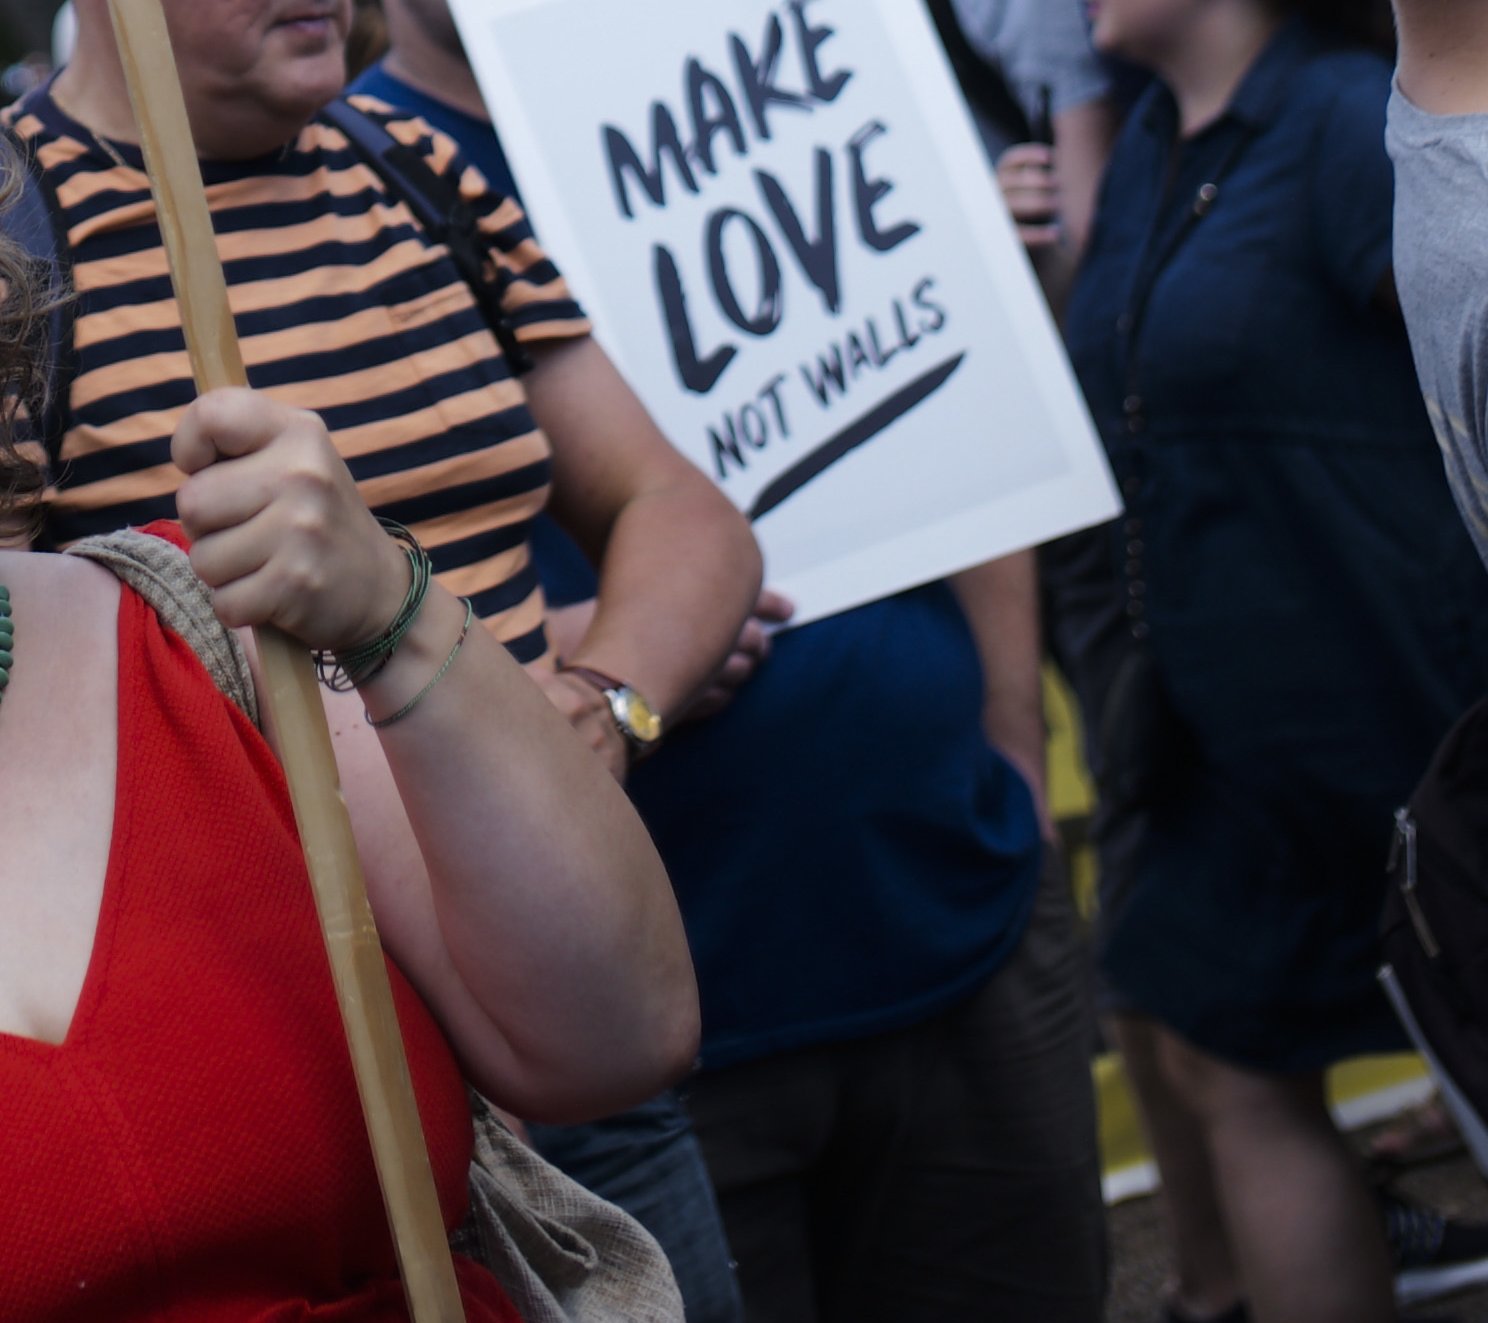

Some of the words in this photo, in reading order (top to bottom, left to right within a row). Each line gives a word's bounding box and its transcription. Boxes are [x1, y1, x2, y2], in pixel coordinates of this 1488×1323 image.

[652, 121, 922, 395] LOVE
[706, 374, 792, 481] NOT
[800, 276, 948, 410] WALLS
